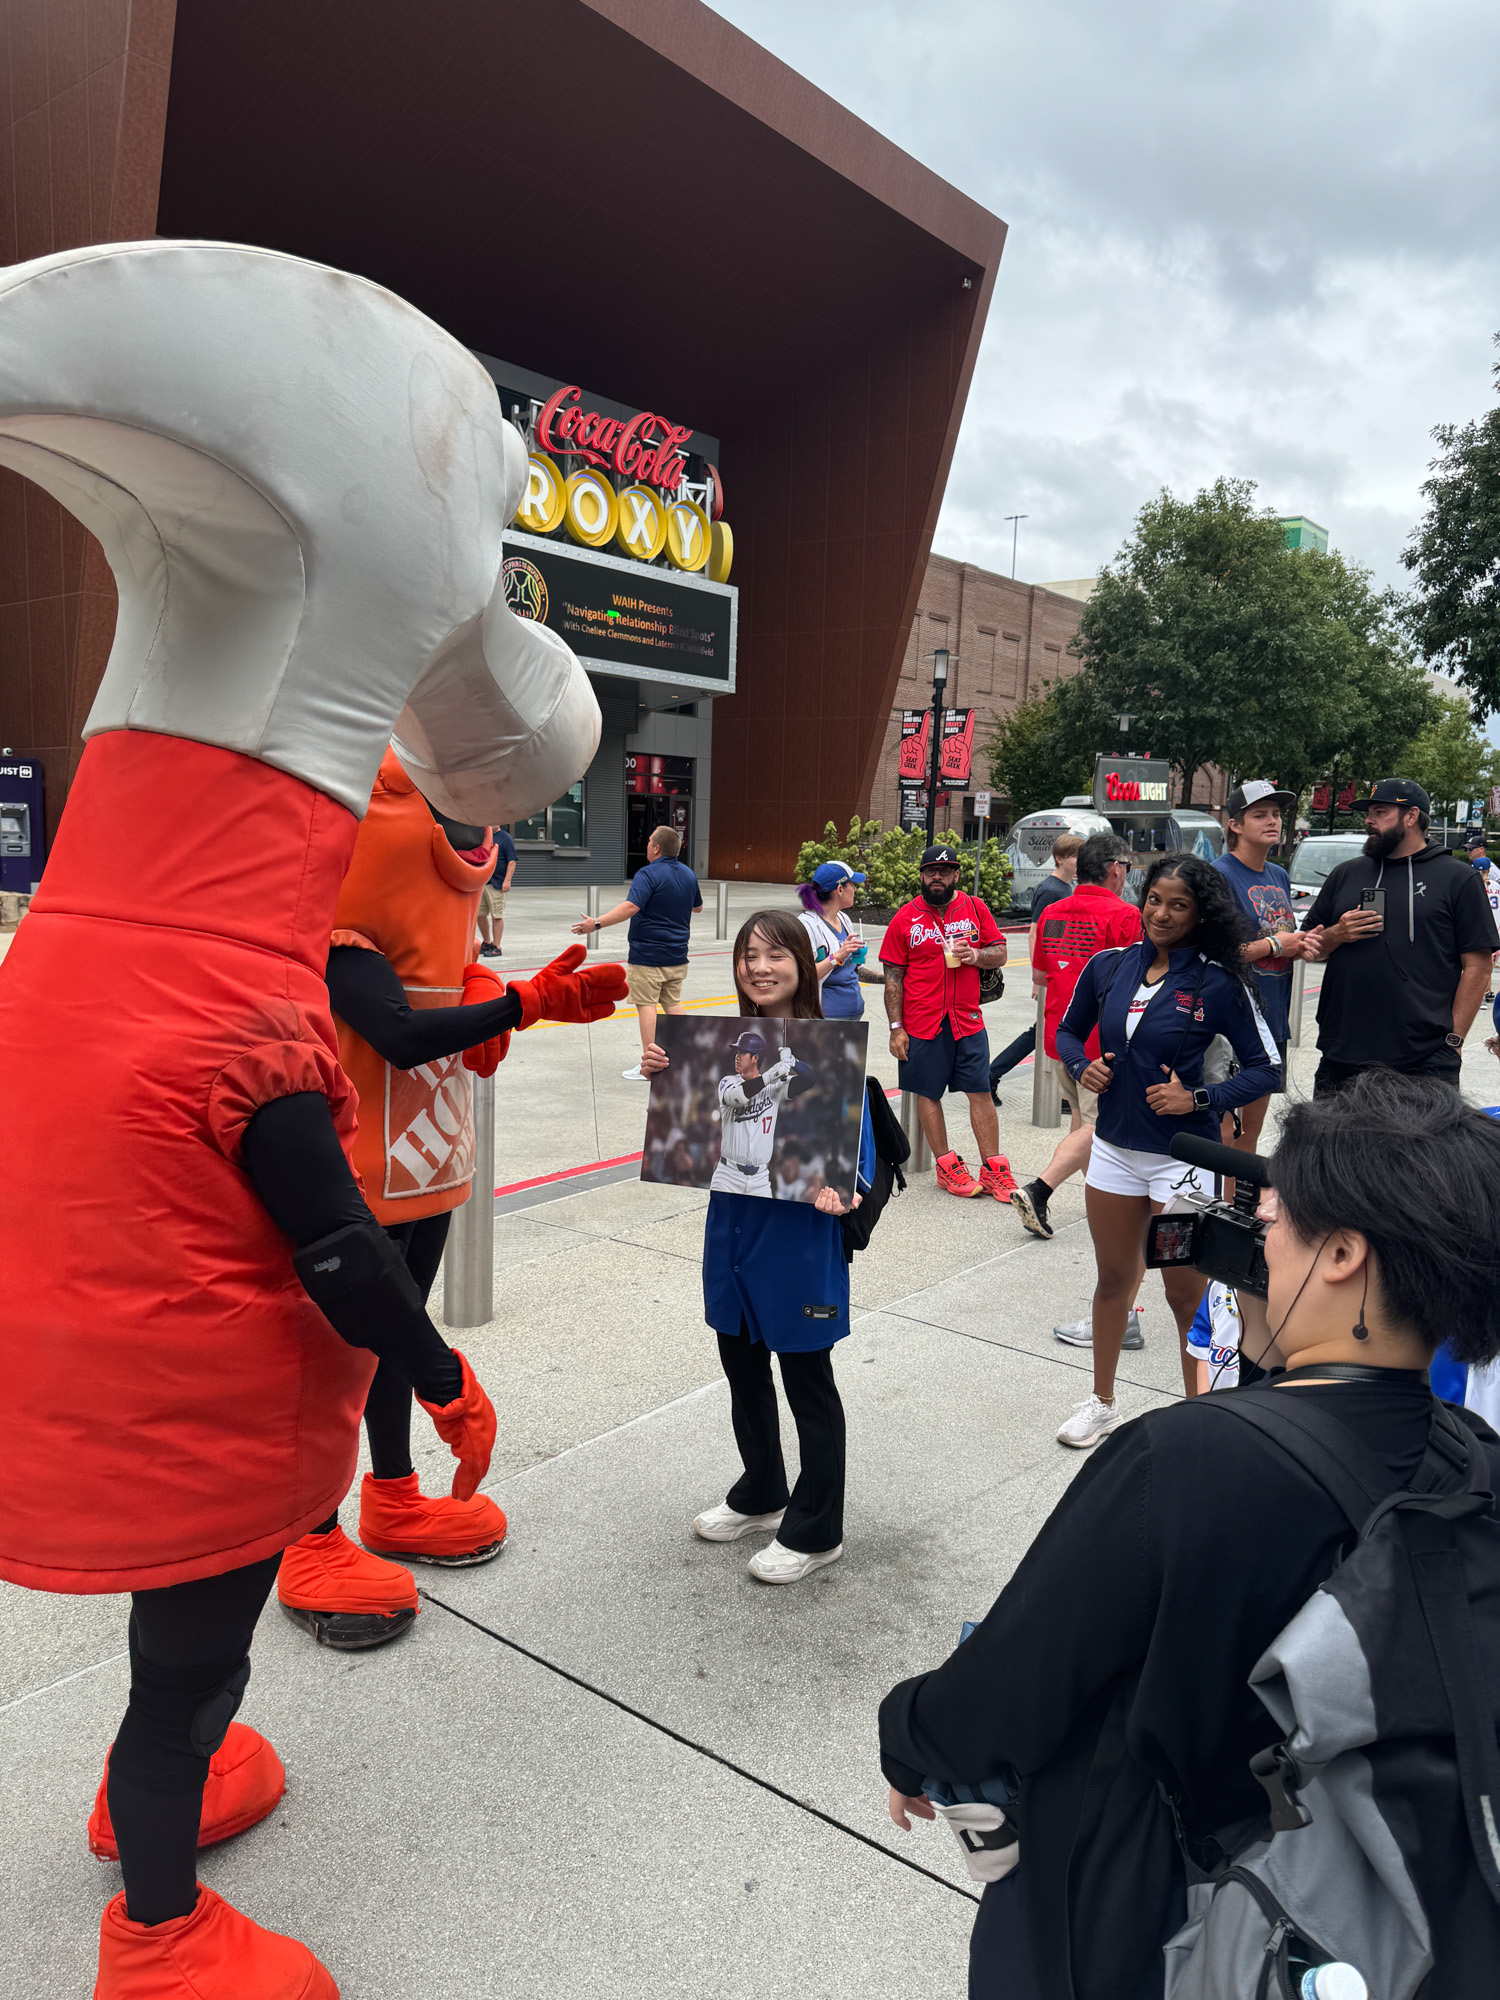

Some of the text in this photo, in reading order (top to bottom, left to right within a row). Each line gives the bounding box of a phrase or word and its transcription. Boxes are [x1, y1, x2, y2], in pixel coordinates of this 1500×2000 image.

[534, 385, 693, 490] Coca-Cola
[522, 463, 699, 560] ROXY
[612, 594, 673, 617] WAIH Presents
[563, 620, 580, 632] With
[607, 629, 641, 643] Clemmons
[642, 636, 654, 646] and
[616, 613, 667, 636] Relationship
[904, 761, 917, 770] GEEK
[946, 761, 961, 770] GEEK
[1105, 772, 1167, 801] Coors LIGHT
[1028, 836, 1056, 846] Silve
[936, 850, 949, 861] A
[1489, 896, 1499, 909] 3
[910, 918, 971, 948] Braves
[762, 1116, 773, 1134] 17
[1170, 1166, 1202, 1190] A
